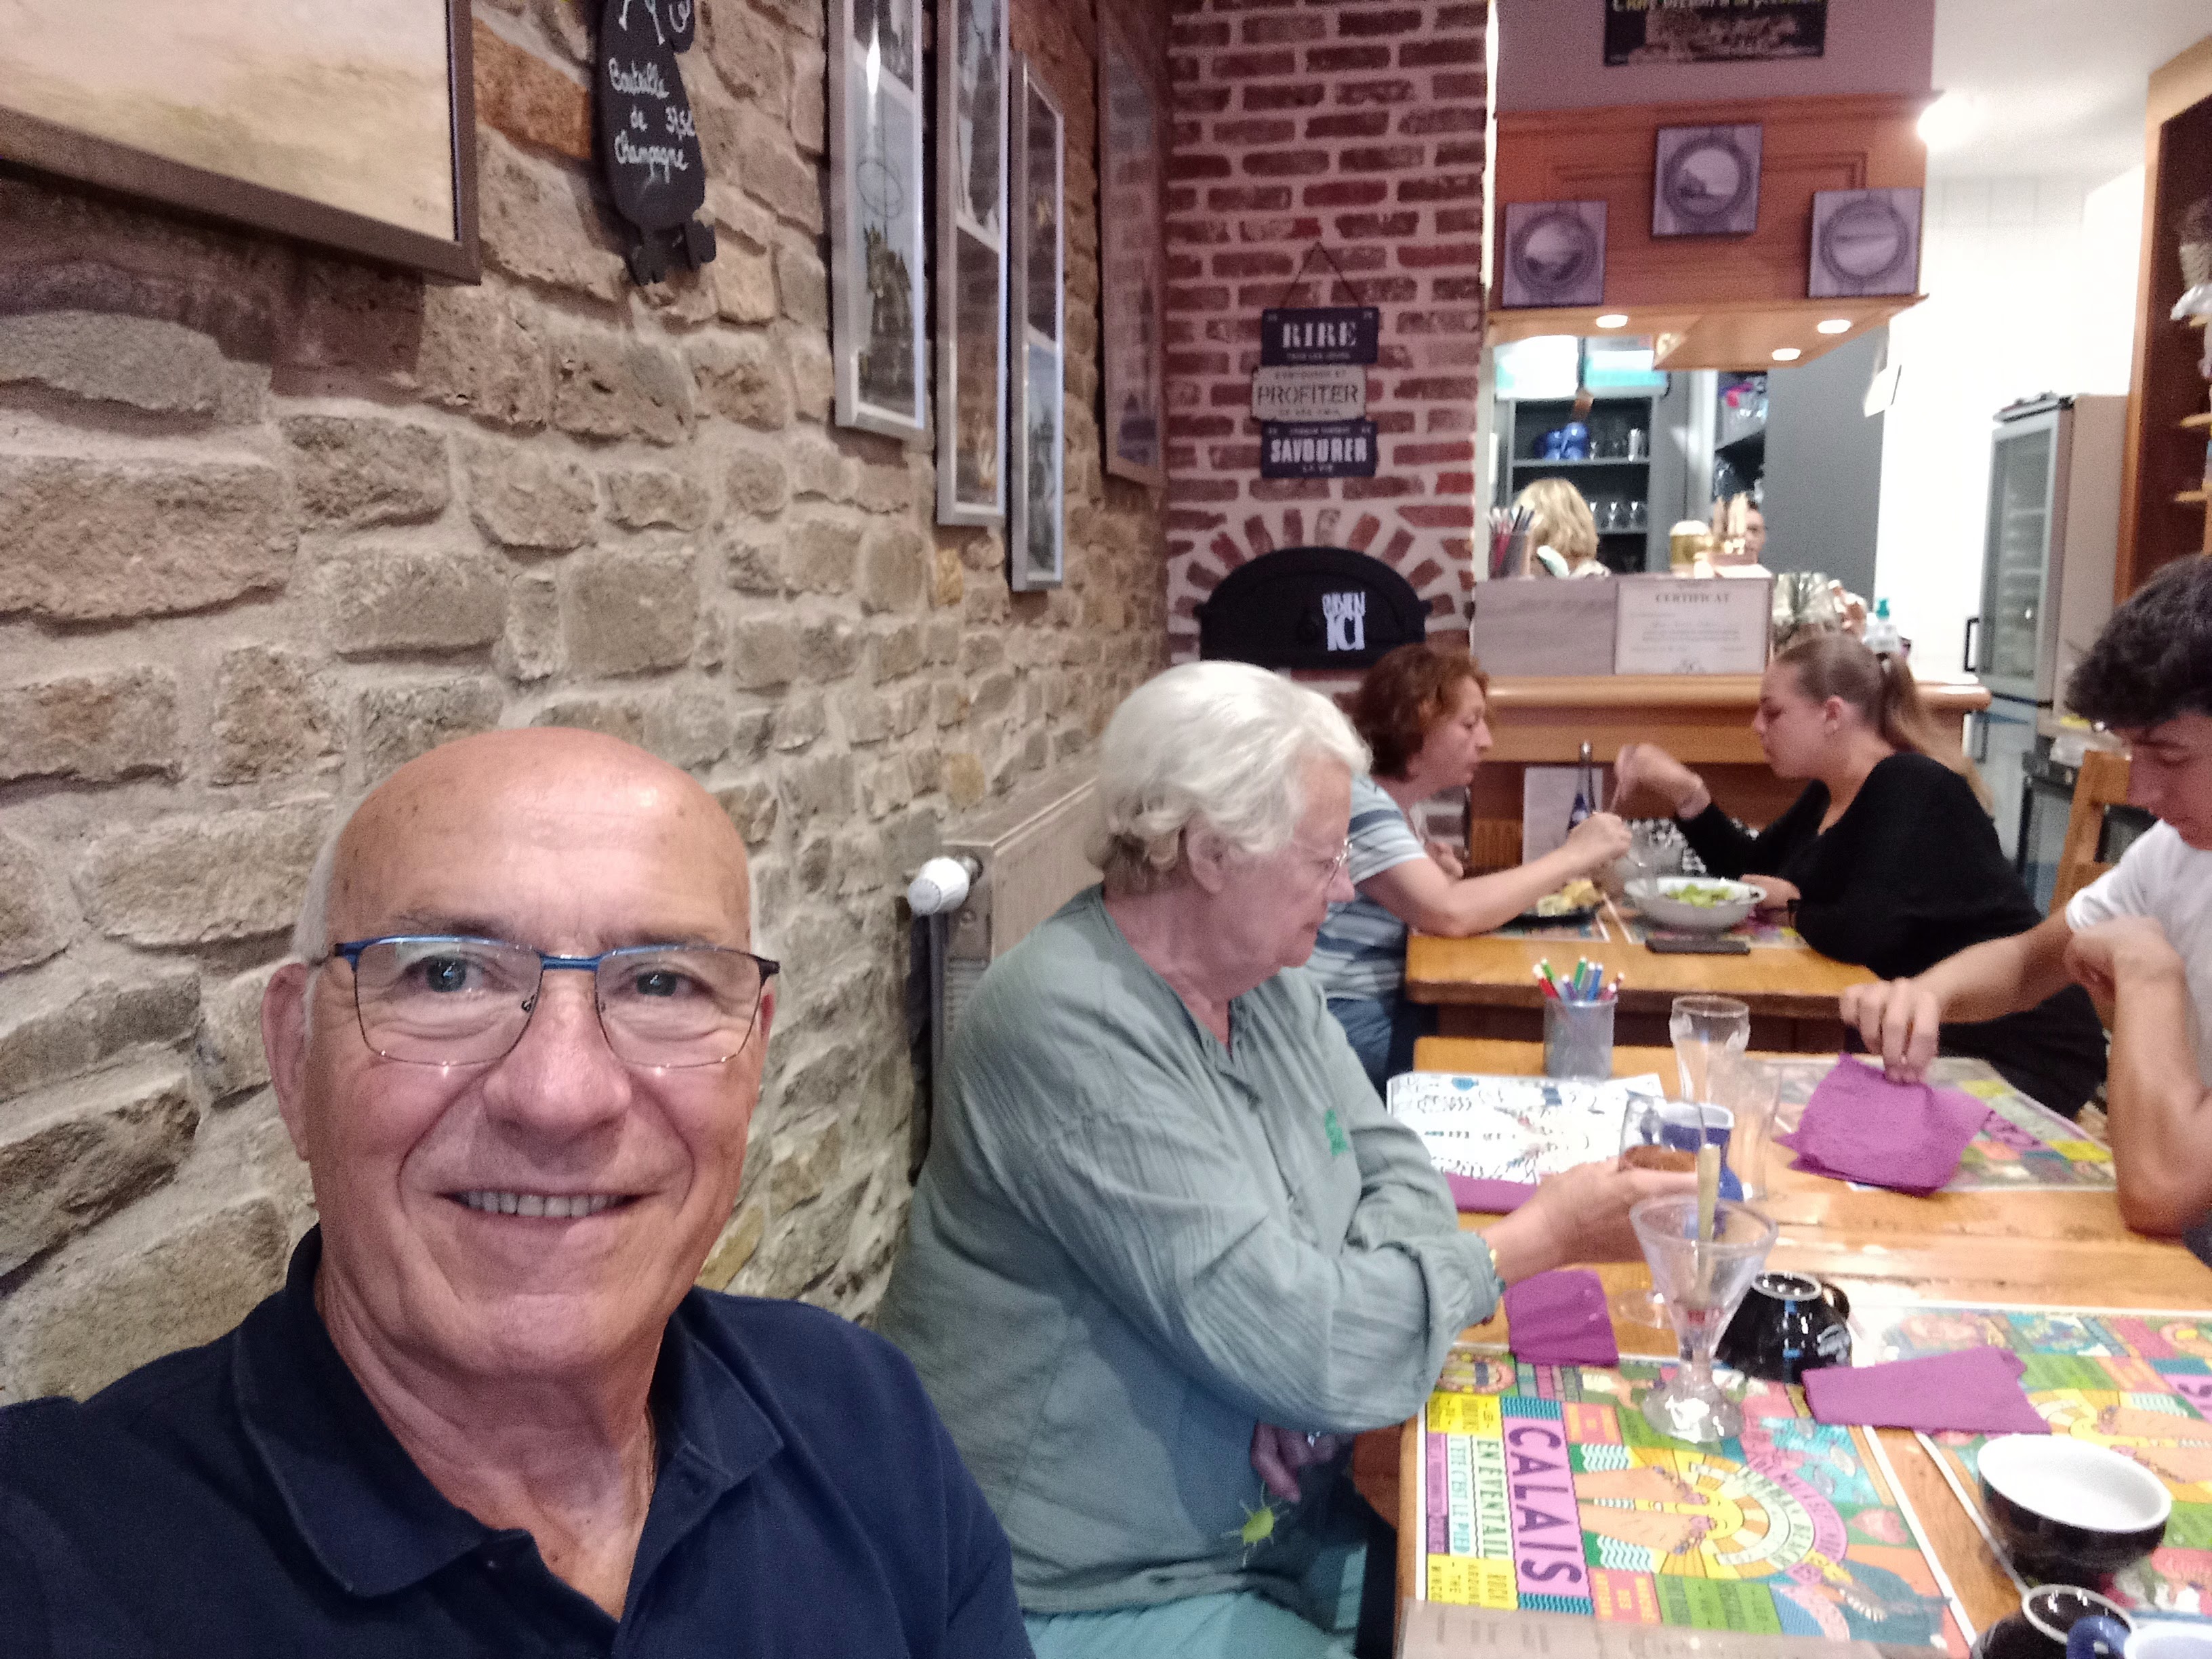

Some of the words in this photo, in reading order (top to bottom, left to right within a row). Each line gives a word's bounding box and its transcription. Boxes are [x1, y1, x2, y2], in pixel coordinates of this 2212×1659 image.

[1282, 321, 1357, 348] RIRE
[1256, 384, 1358, 405] PROFITER
[1271, 437, 1367, 463] SAVOURER
[1656, 593, 1729, 603] CERTIFICAT
[1476, 1439, 1501, 1460] EN
[1509, 1427, 1582, 1583] CALAIS
